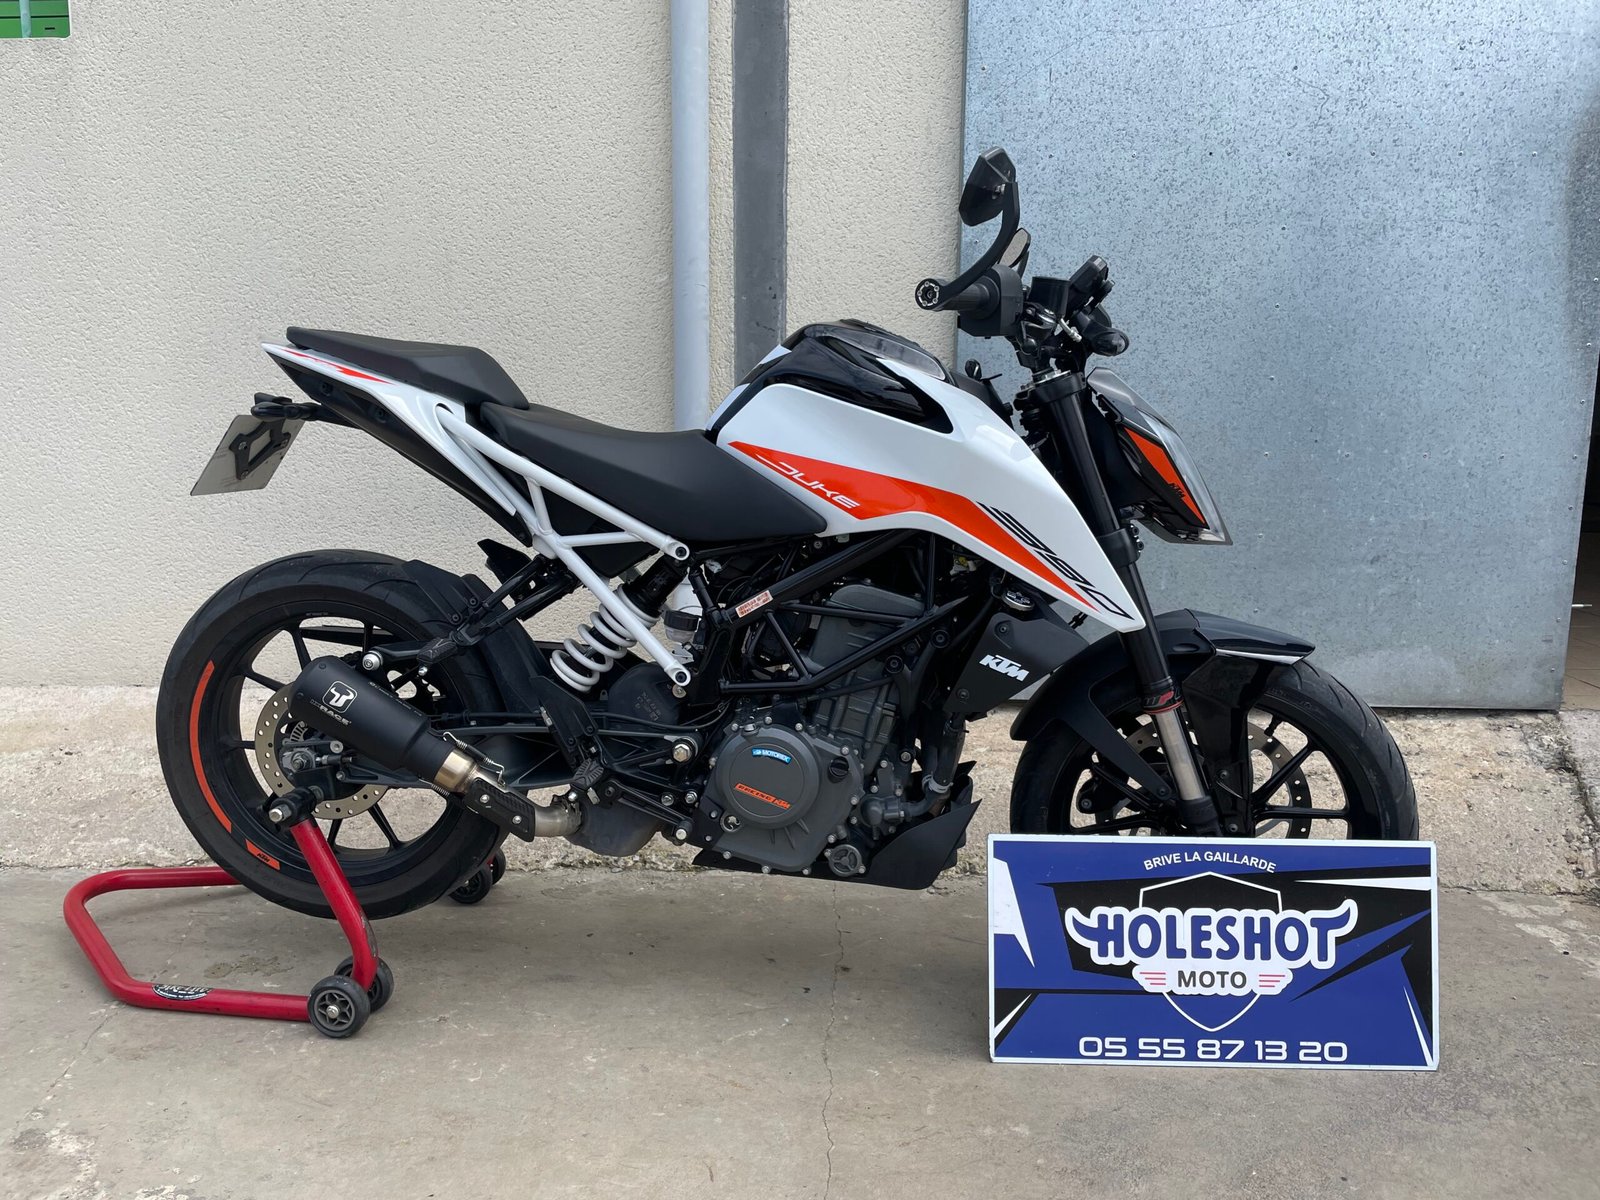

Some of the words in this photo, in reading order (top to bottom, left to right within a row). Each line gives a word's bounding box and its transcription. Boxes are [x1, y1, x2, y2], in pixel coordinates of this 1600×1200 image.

[755, 453, 861, 509] DUKE
[979, 654, 1029, 682] KTM
[1143, 852, 1181, 871] BRIVE
[1184, 851, 1202, 862] LA
[1203, 851, 1276, 873] GAILLARDE
[1069, 905, 1352, 963] HOLESHOT
[1177, 970, 1248, 989] MOTO
[1079, 1036, 1128, 1057] 05
[1138, 1038, 1186, 1059] 55
[1197, 1039, 1245, 1060] 87
[1254, 1040, 1288, 1061] 13
[1299, 1041, 1349, 1062] 20
